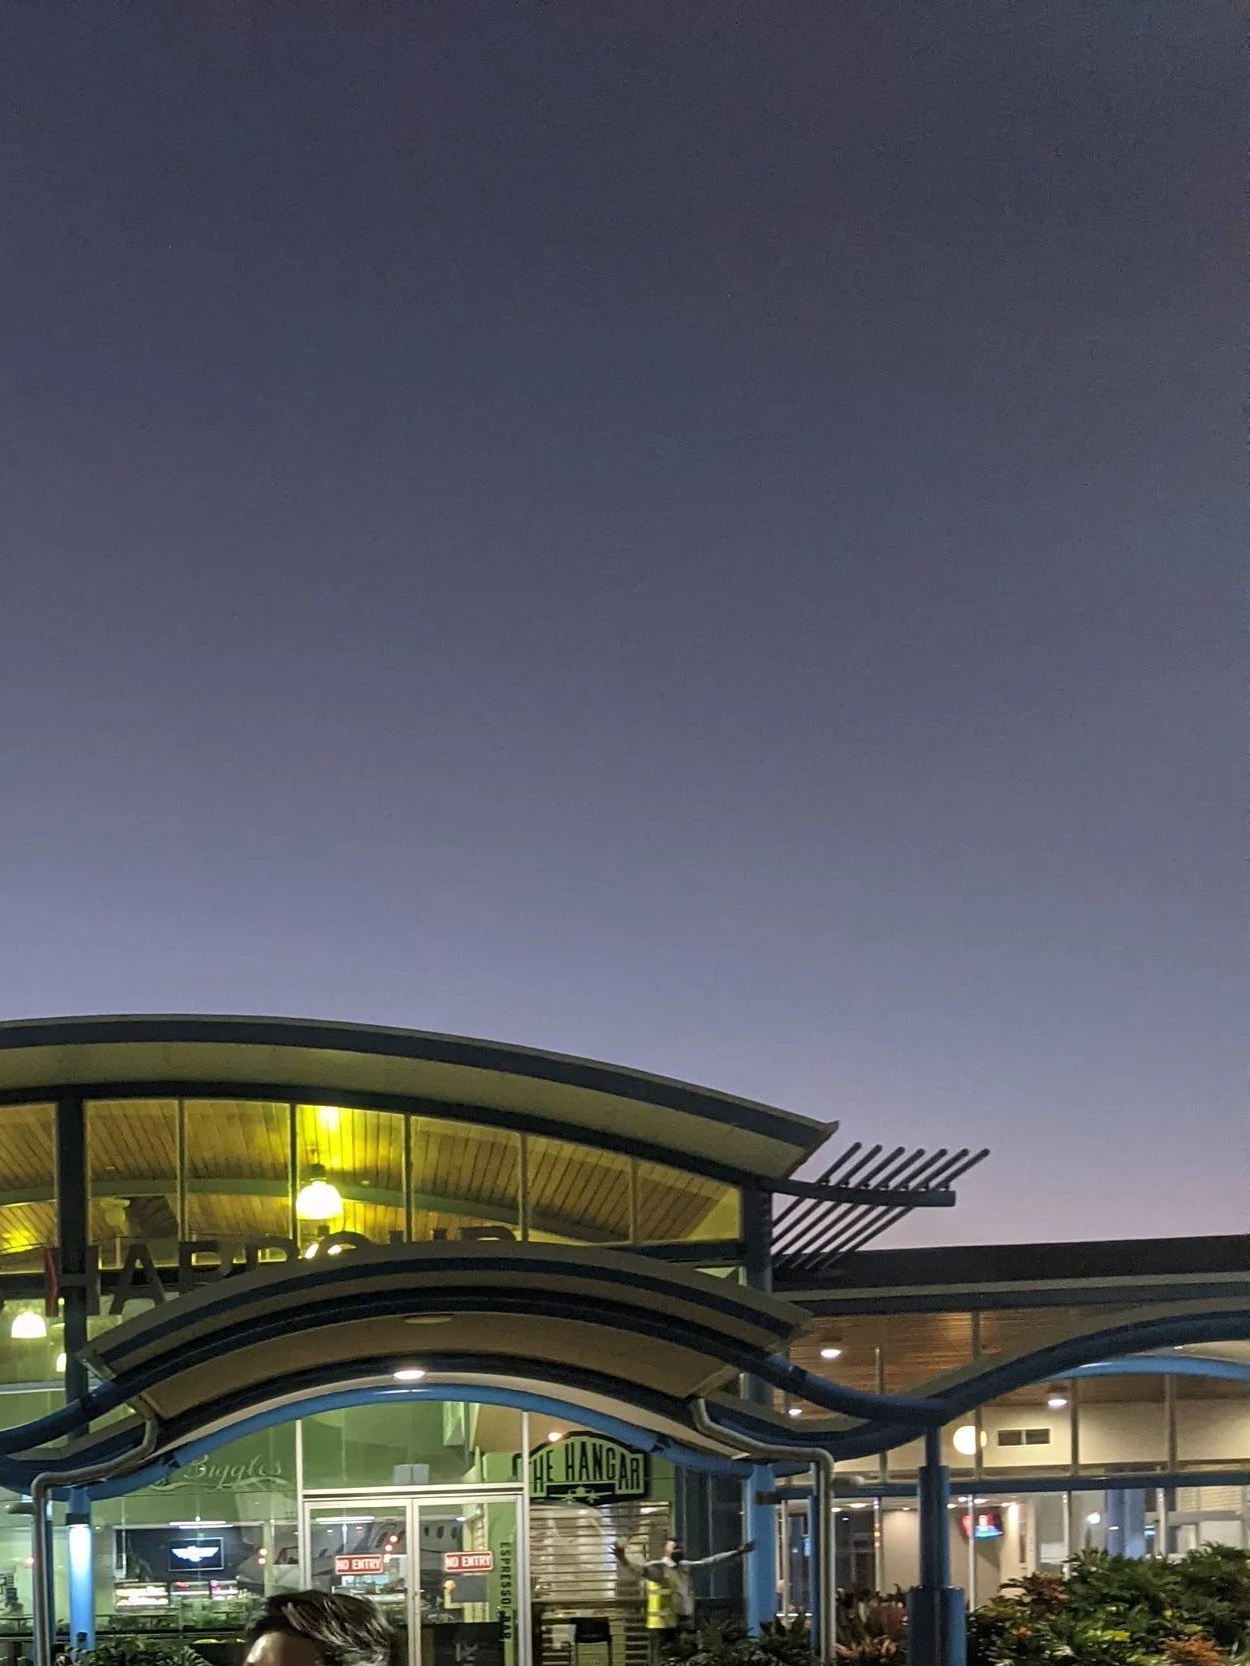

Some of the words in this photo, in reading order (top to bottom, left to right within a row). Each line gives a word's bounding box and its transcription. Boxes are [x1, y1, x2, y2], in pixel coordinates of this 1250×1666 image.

[183, 1455, 282, 1490] Biggles
[565, 1441, 641, 1490] HANGAR
[335, 1559, 349, 1570] NO
[352, 1558, 382, 1570] ENTRY
[446, 1557, 459, 1568] NO
[462, 1555, 492, 1568] ENTRY
[500, 1542, 512, 1605] ESPRESSO
